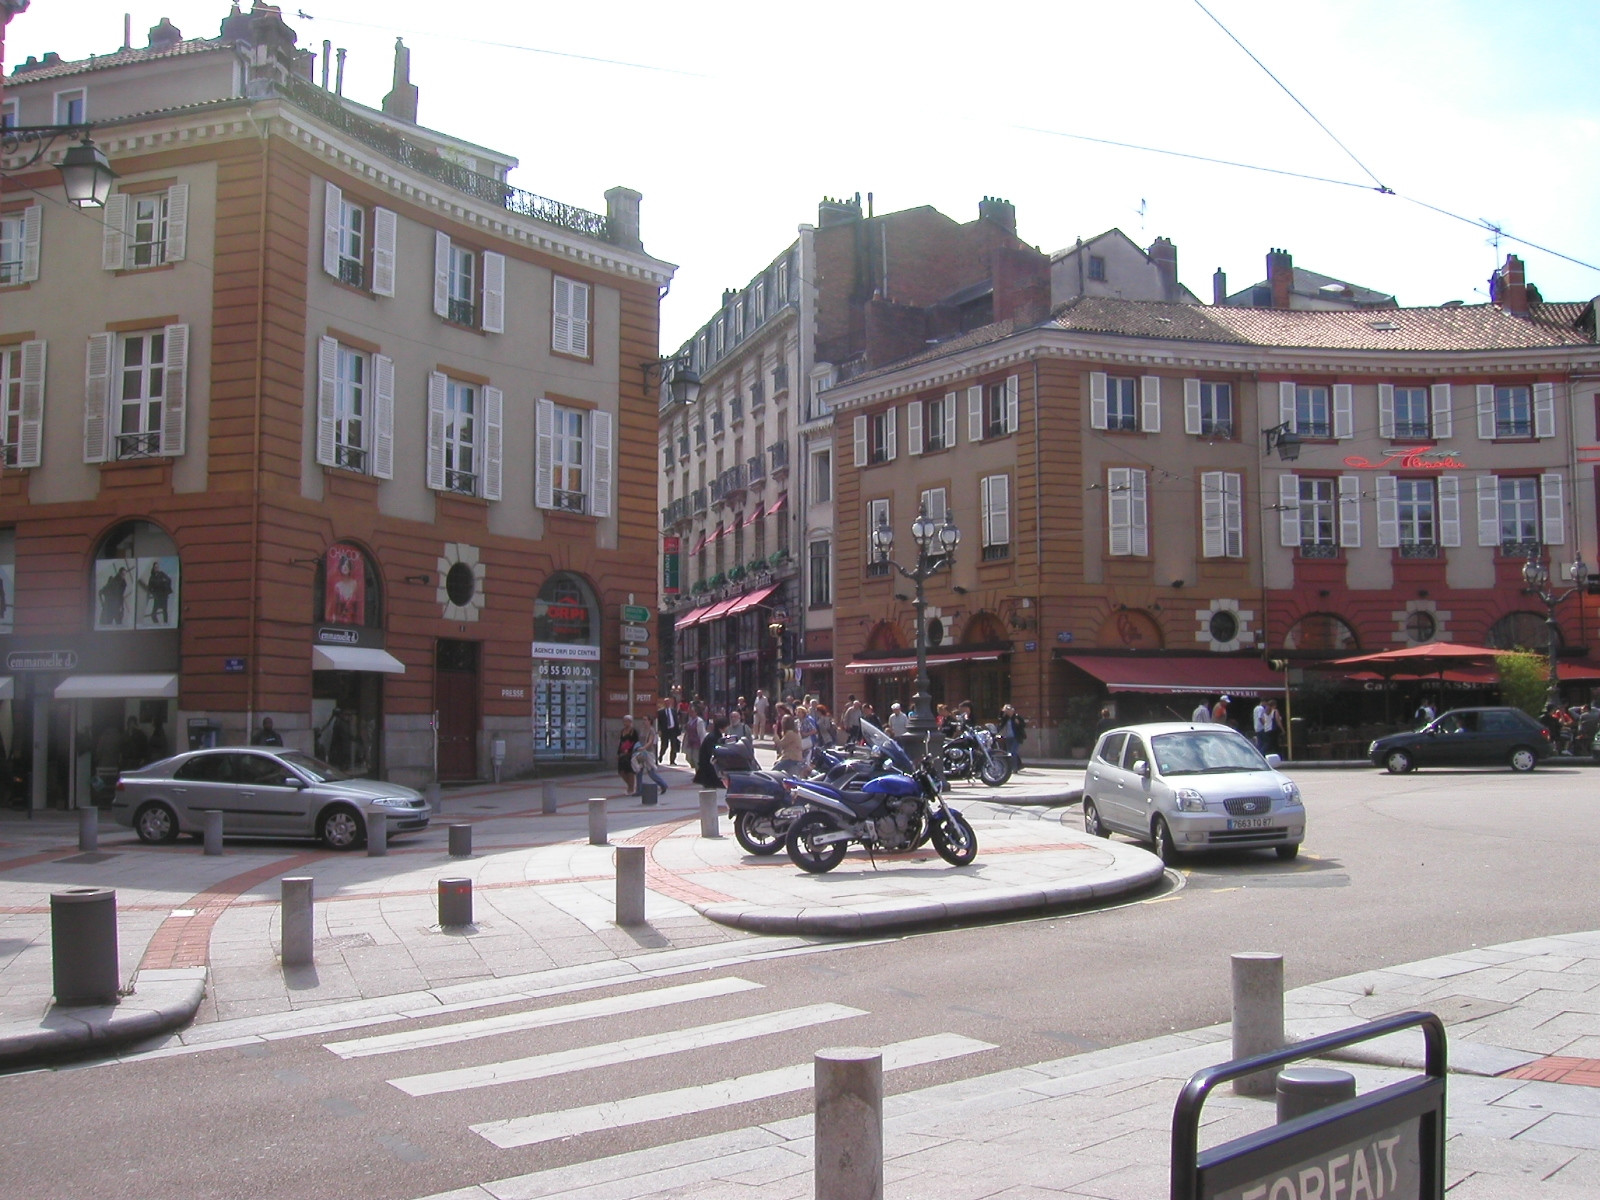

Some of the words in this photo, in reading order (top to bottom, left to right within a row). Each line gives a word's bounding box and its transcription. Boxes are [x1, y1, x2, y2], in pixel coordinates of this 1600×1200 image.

[548, 606, 586, 620] ORPI
[321, 631, 350, 642] emmanuelle
[534, 647, 554, 655] AGENCE
[577, 649, 597, 657] CENTRE
[10, 652, 62, 668] emmanuelle
[538, 665, 549, 675] 05
[550, 666, 560, 675] 55
[562, 666, 572, 676] 50
[573, 667, 580, 676] 10
[581, 667, 591, 677] 20
[501, 689, 524, 697] PRESSE
[1242, 1135, 1400, 1200] RFAIT
